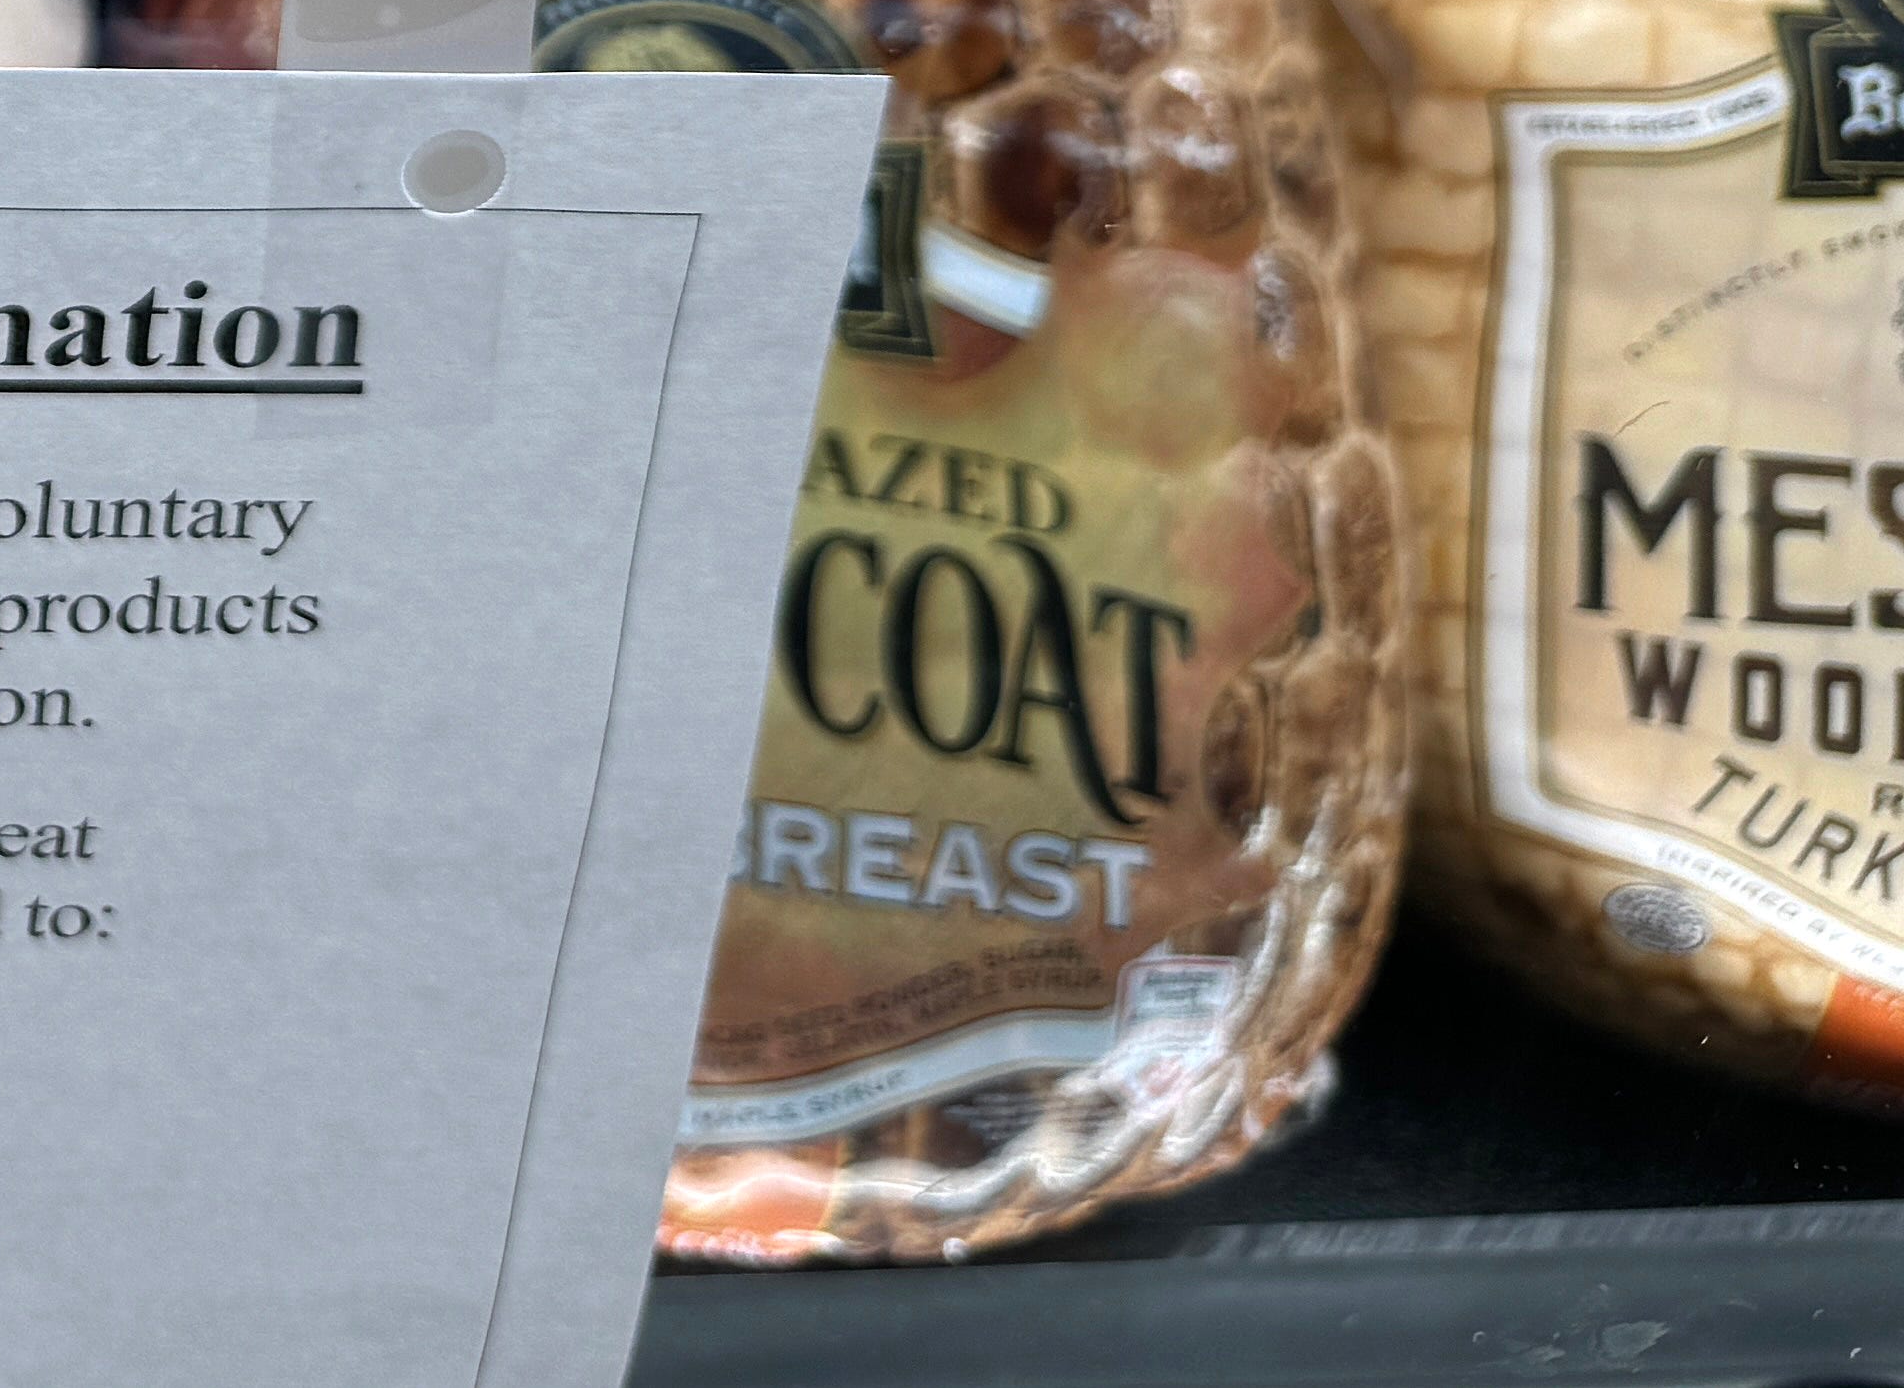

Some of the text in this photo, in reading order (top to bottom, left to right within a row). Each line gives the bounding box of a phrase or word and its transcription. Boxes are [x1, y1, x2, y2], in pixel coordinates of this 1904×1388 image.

[802, 425, 1076, 536] AZED
[775, 527, 1192, 829] COAT
[1616, 626, 1904, 761] WOO
[26, 896, 115, 941] to:
[730, 800, 1154, 932] REAST
